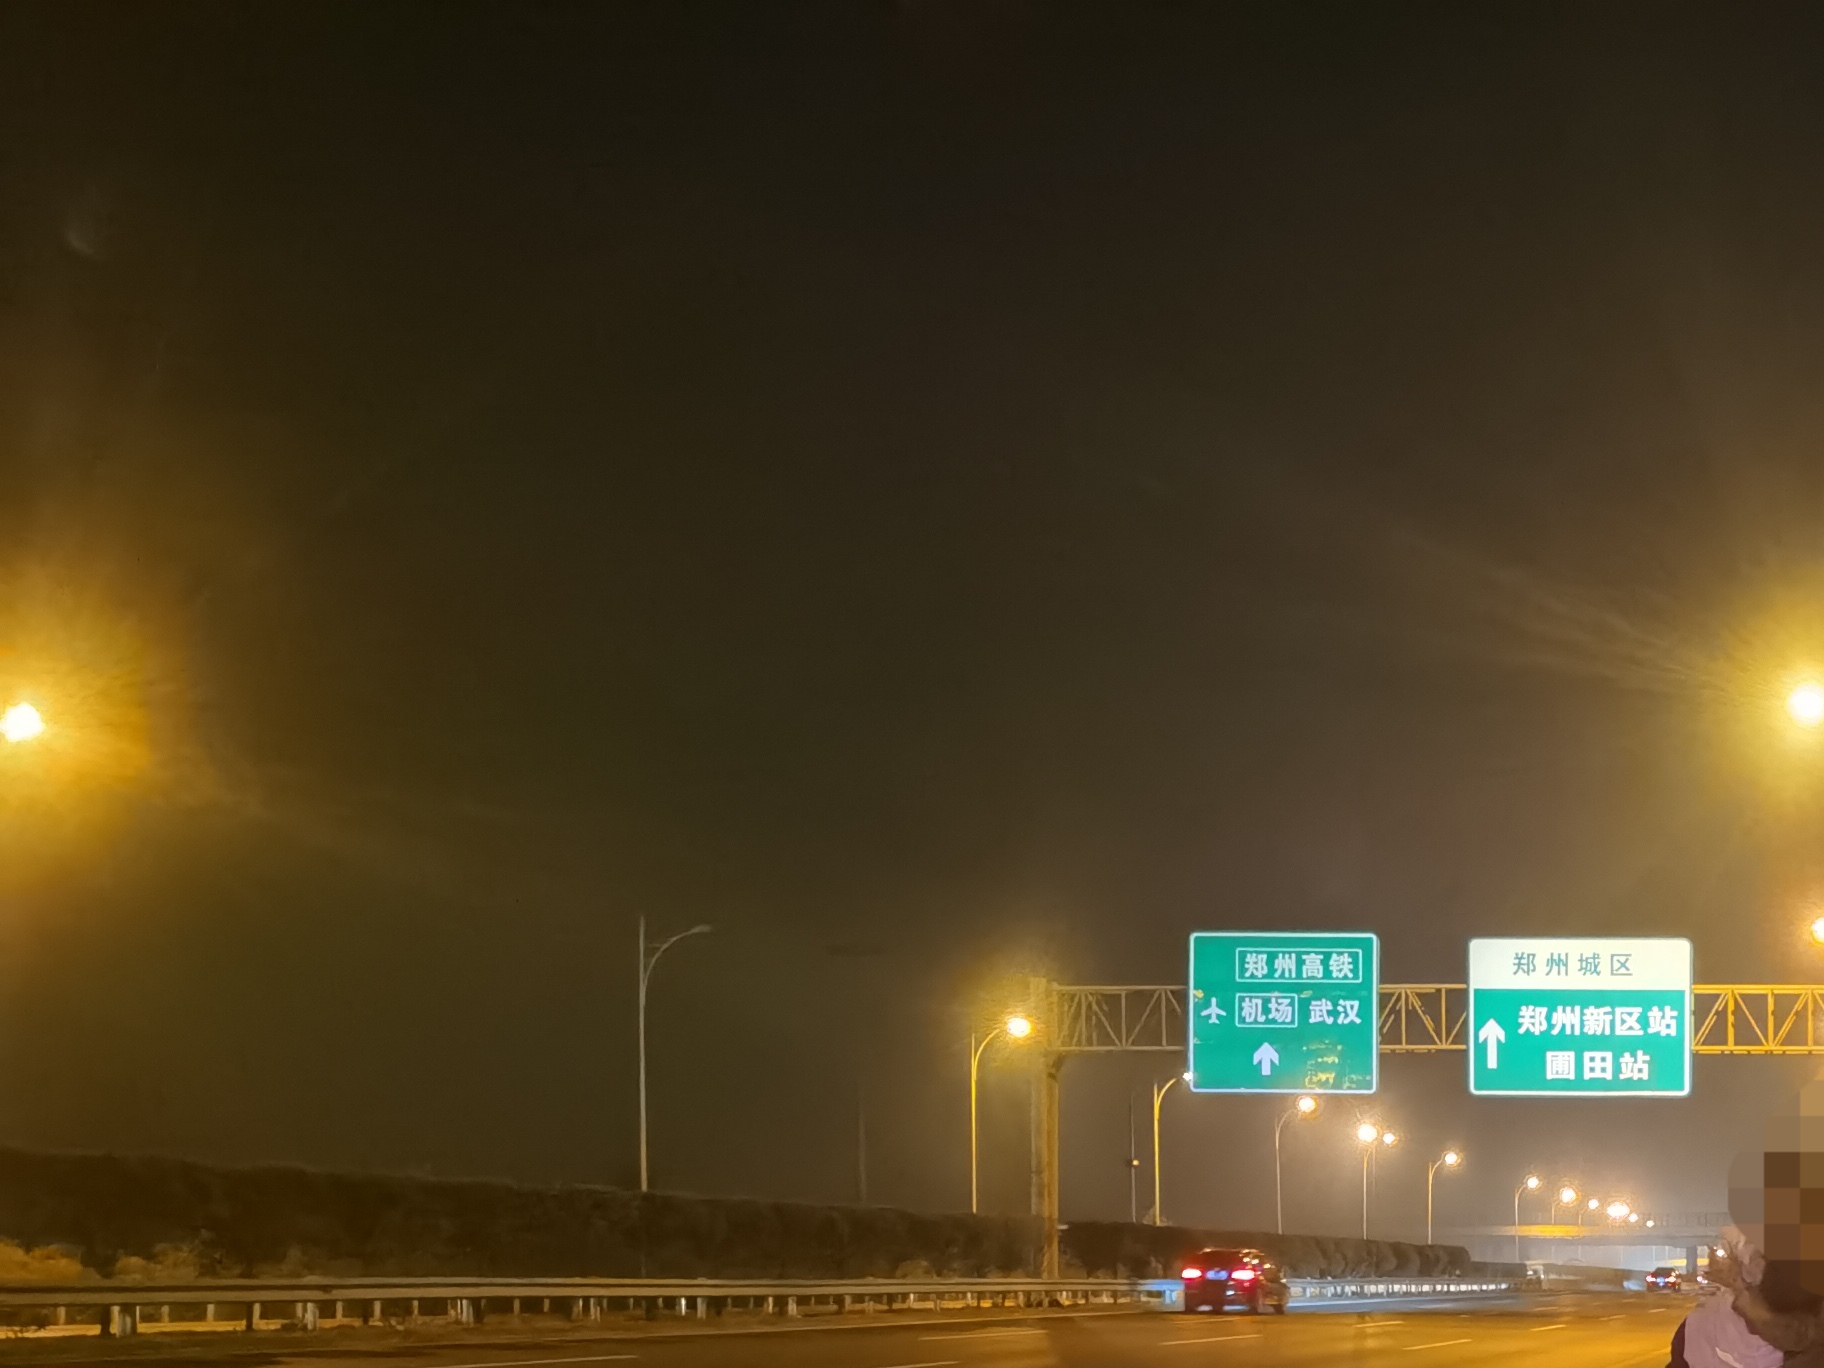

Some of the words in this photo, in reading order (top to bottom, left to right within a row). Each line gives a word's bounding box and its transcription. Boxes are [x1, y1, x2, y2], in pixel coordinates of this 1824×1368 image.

[1244, 953, 1354, 979] 郑州高铁
[1513, 952, 1633, 977] 郑州城区
[1241, 997, 1293, 1023] 机场
[1308, 998, 1361, 1025] 武汉
[1518, 1005, 1678, 1037] 郑州新区站
[1545, 1050, 1650, 1081] 圃田站
